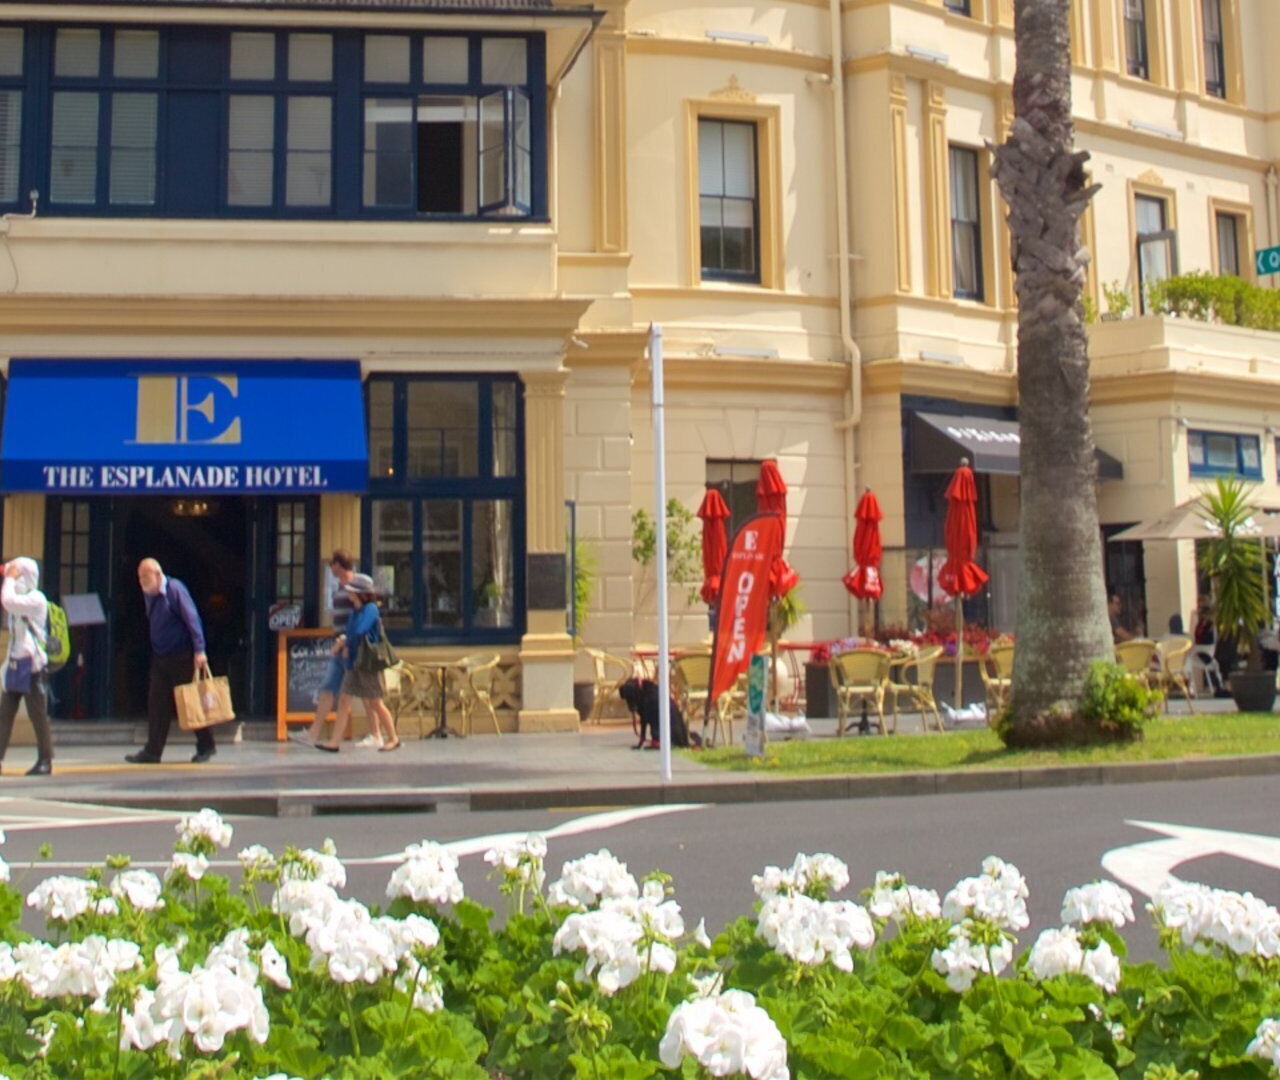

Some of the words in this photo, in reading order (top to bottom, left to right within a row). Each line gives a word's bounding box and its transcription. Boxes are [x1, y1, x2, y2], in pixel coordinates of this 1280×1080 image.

[43, 465, 94, 488] THE
[101, 465, 240, 489] ESPLANADE
[245, 466, 328, 488] HOTEL
[271, 613, 300, 628] OPEN
[726, 571, 755, 664] OPEN
